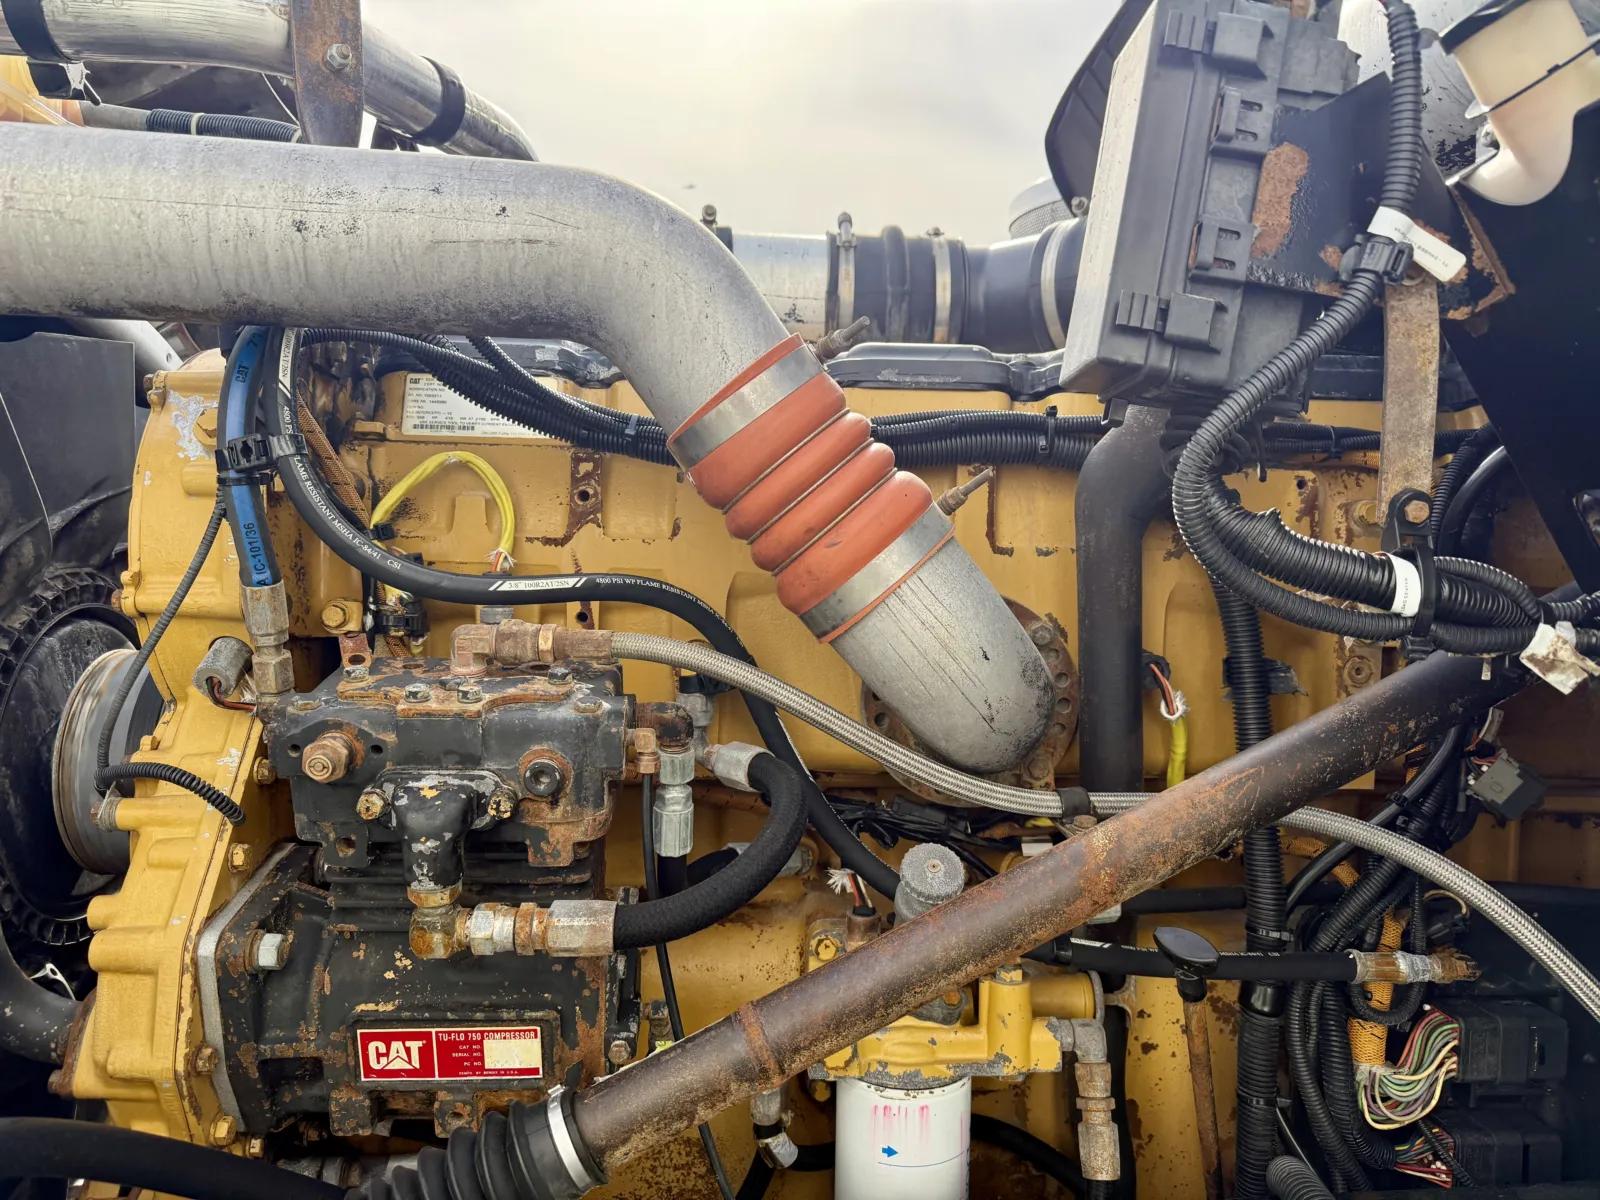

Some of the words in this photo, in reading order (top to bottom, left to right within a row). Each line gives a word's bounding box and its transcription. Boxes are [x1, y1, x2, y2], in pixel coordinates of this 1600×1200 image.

[235, 364, 250, 384] CAT
[409, 377, 421, 385] CAT
[283, 405, 292, 423] 4800
[285, 424, 294, 434] PS
[294, 455, 309, 481] LAME
[304, 480, 336, 521] RESISTANT
[332, 518, 354, 541] MSHA
[353, 537, 383, 560] IC-84/41
[387, 559, 402, 570] CSI
[243, 522, 267, 575] IC-101/36
[595, 577, 612, 585] 4800
[612, 577, 624, 585] PSI
[636, 579, 661, 589] FLAME
[661, 583, 697, 603] RESISTANT
[438, 1032, 466, 1042] TU-FLO
[467, 1032, 482, 1041] 750
[483, 1031, 536, 1041] COMPRESSOR
[367, 1040, 424, 1070] CAT
